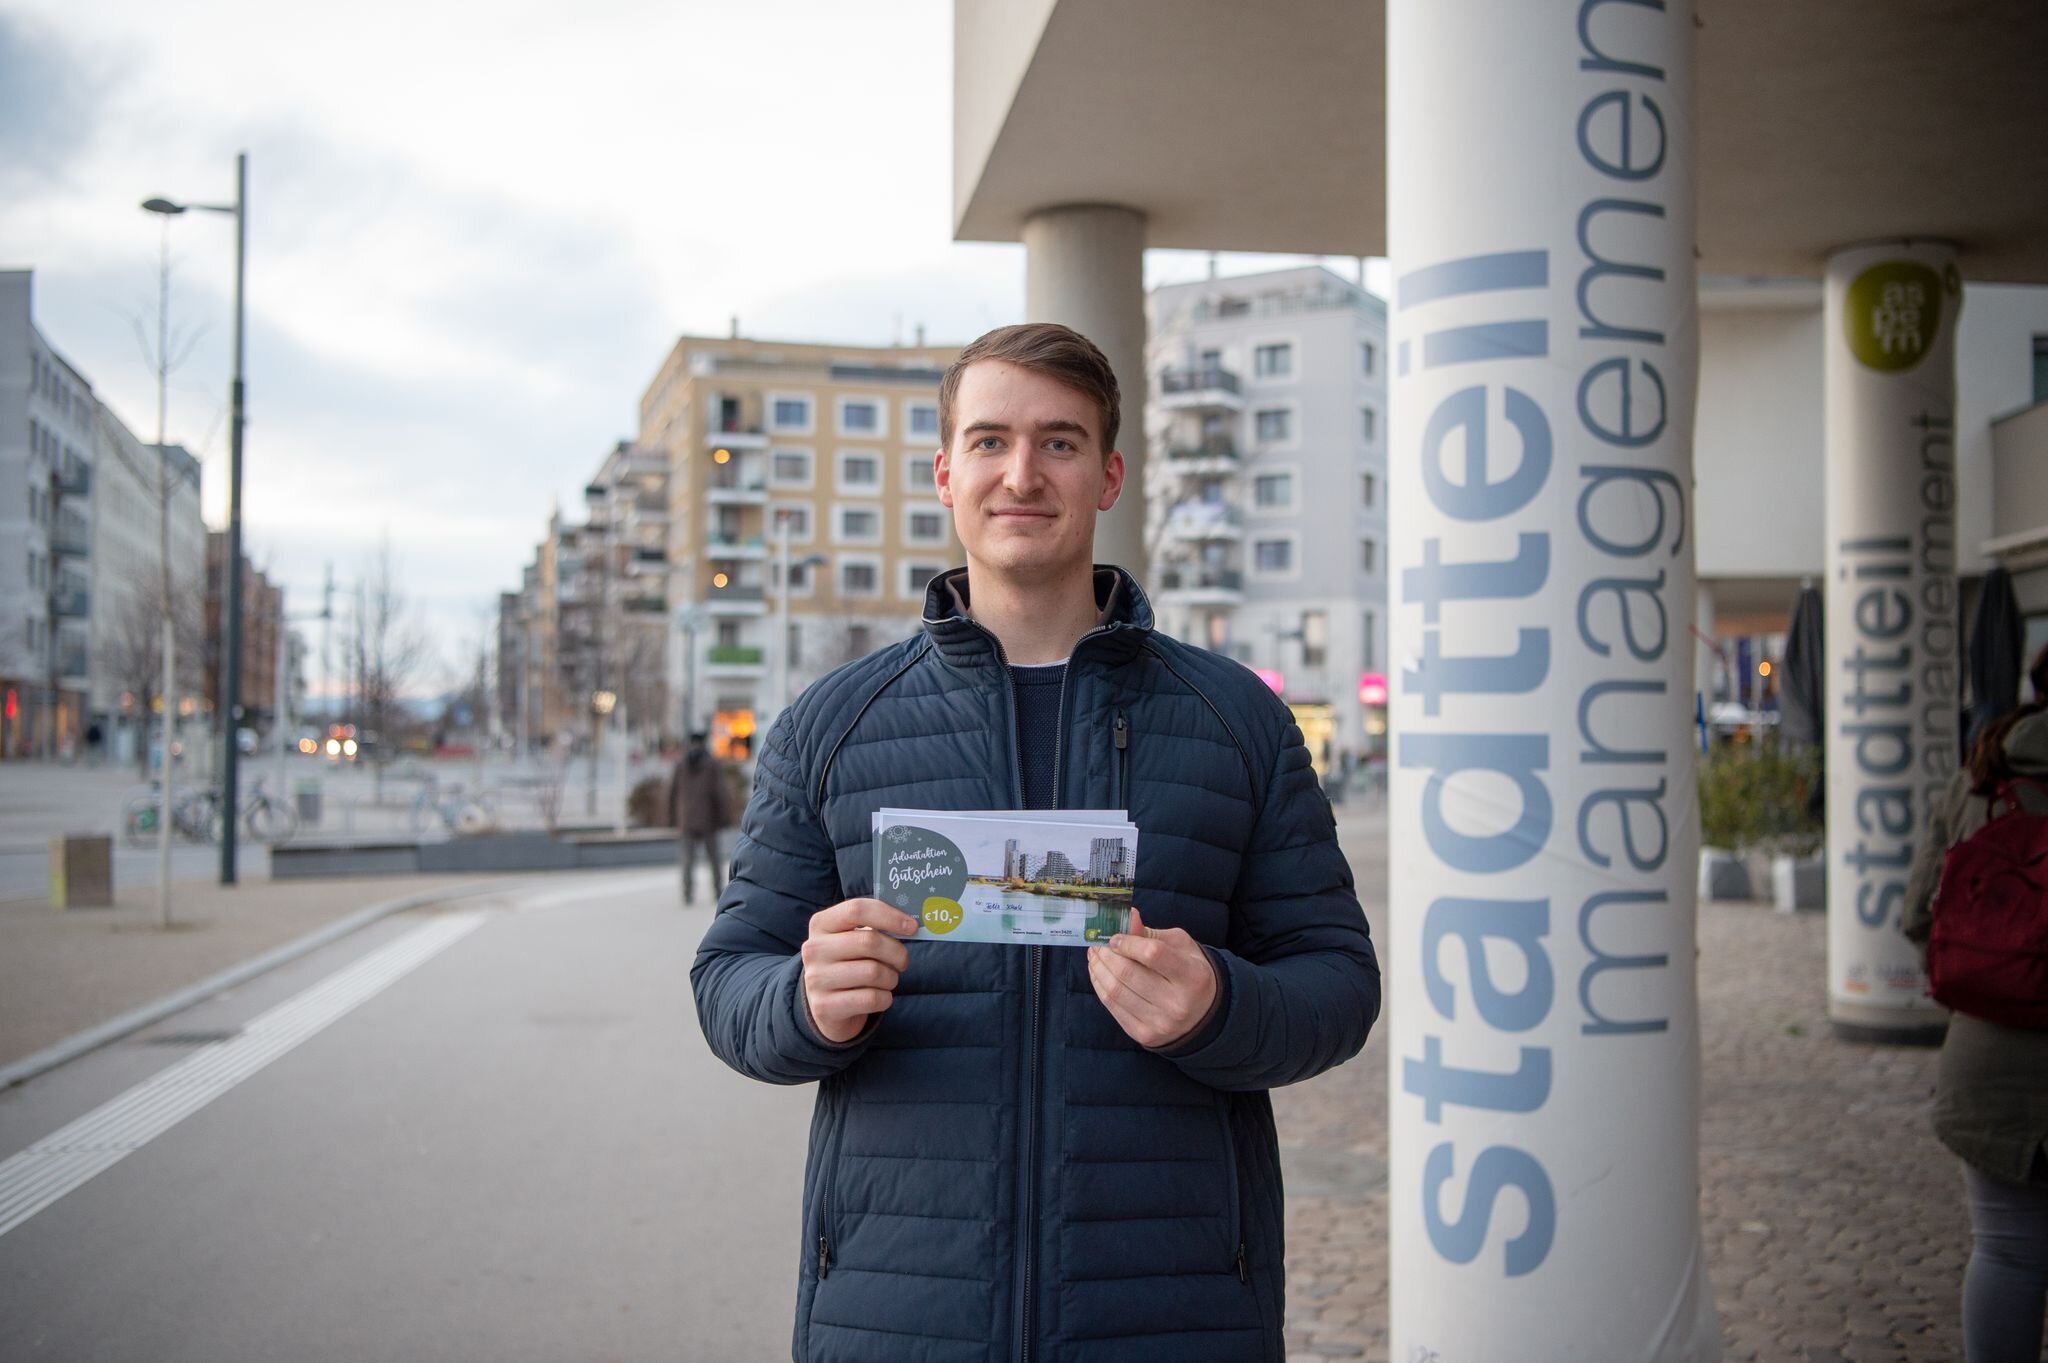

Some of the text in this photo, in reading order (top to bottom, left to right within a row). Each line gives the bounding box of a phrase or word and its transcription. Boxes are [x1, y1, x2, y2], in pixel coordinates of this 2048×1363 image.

[1576, 0, 1685, 1036] managemen
[1397, 249, 1557, 1278] stadtteil
[1839, 536, 1913, 928] stadtteil
[888, 847, 947, 864] Adventaktion
[888, 862, 952, 889] Gutschein
[925, 909, 959, 924] €10,-
